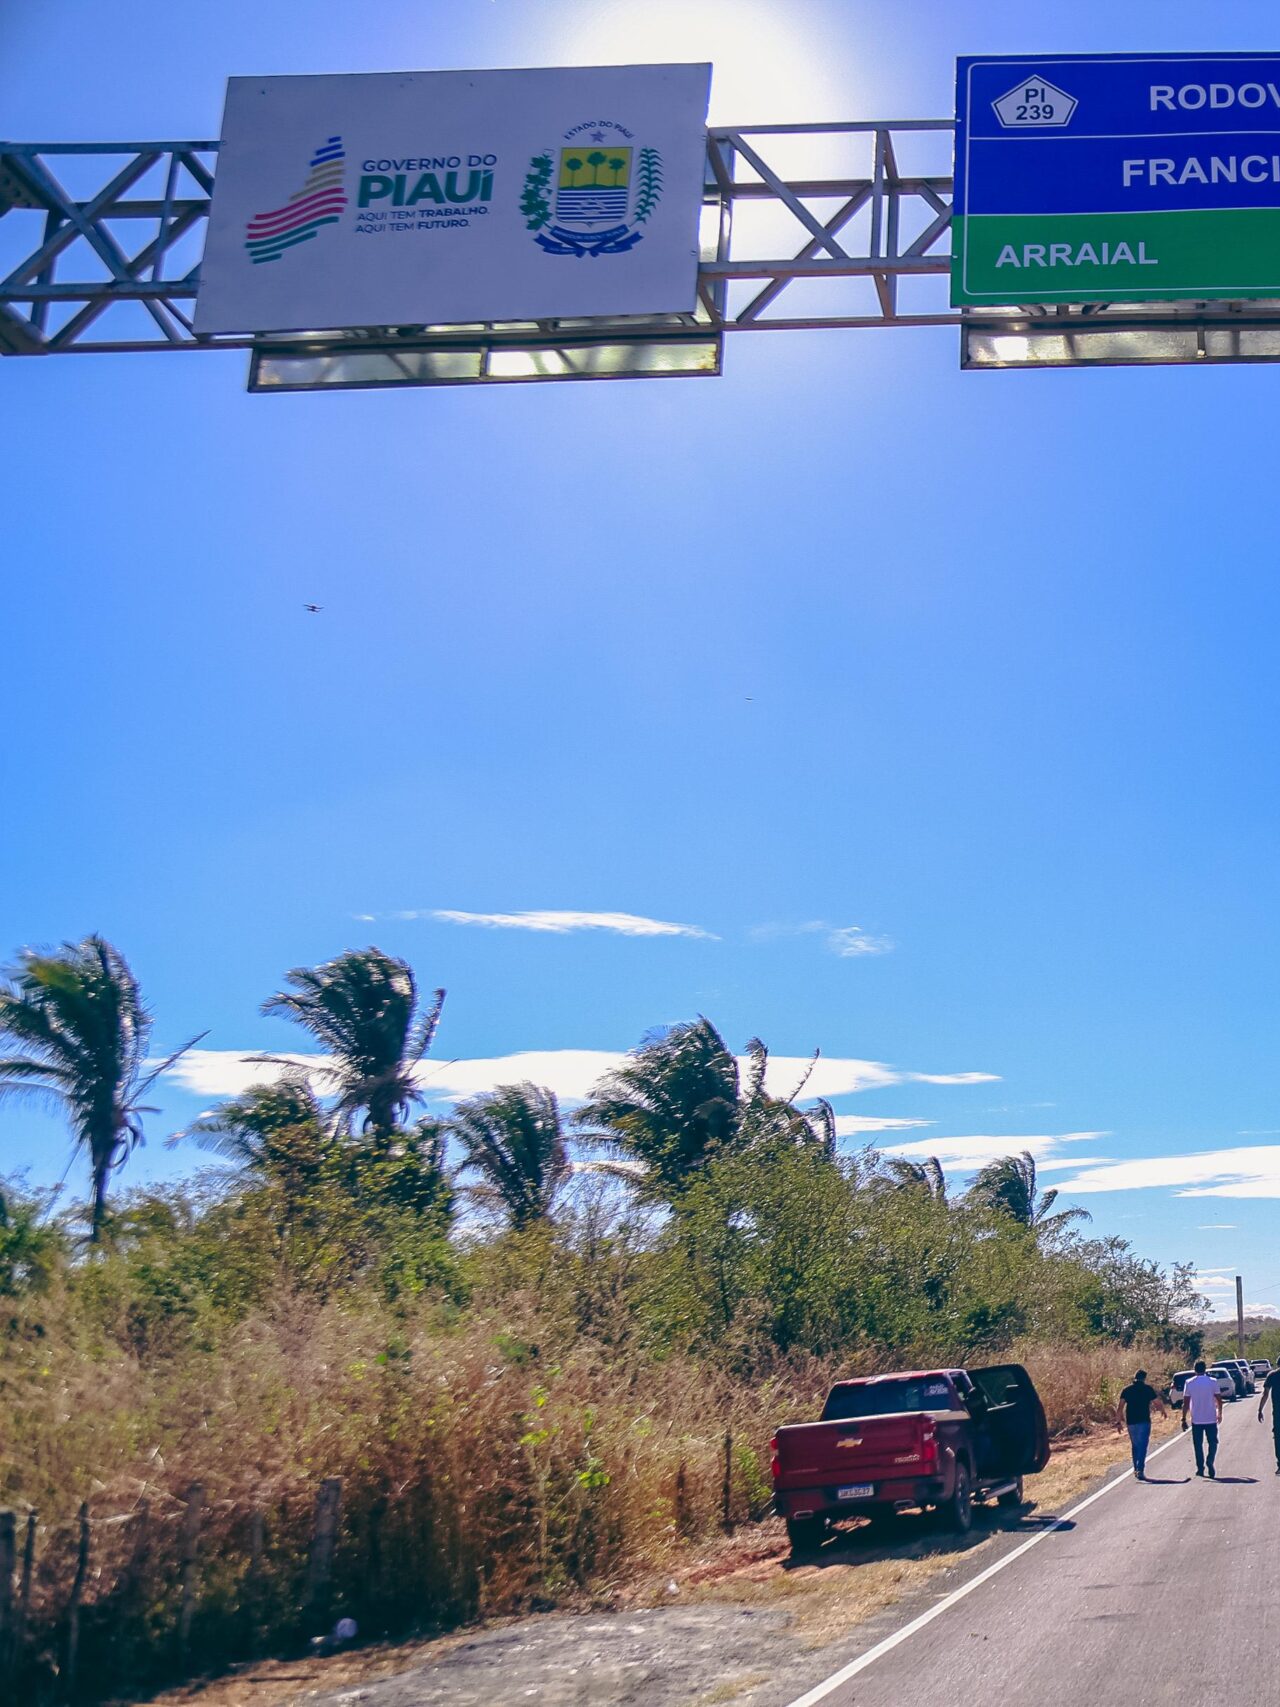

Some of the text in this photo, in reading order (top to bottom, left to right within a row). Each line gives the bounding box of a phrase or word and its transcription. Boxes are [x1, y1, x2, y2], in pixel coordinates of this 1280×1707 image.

[1025, 88, 1046, 103] PI
[1016, 105, 1054, 121] 239
[362, 154, 497, 172] GOVERNO DO
[357, 169, 494, 208] PIAUÍ
[357, 206, 490, 222] AQUI TEM TRABALHO.
[355, 218, 470, 234] AQUI TEM FUTURO.
[995, 241, 1159, 268] ARRAIAL
